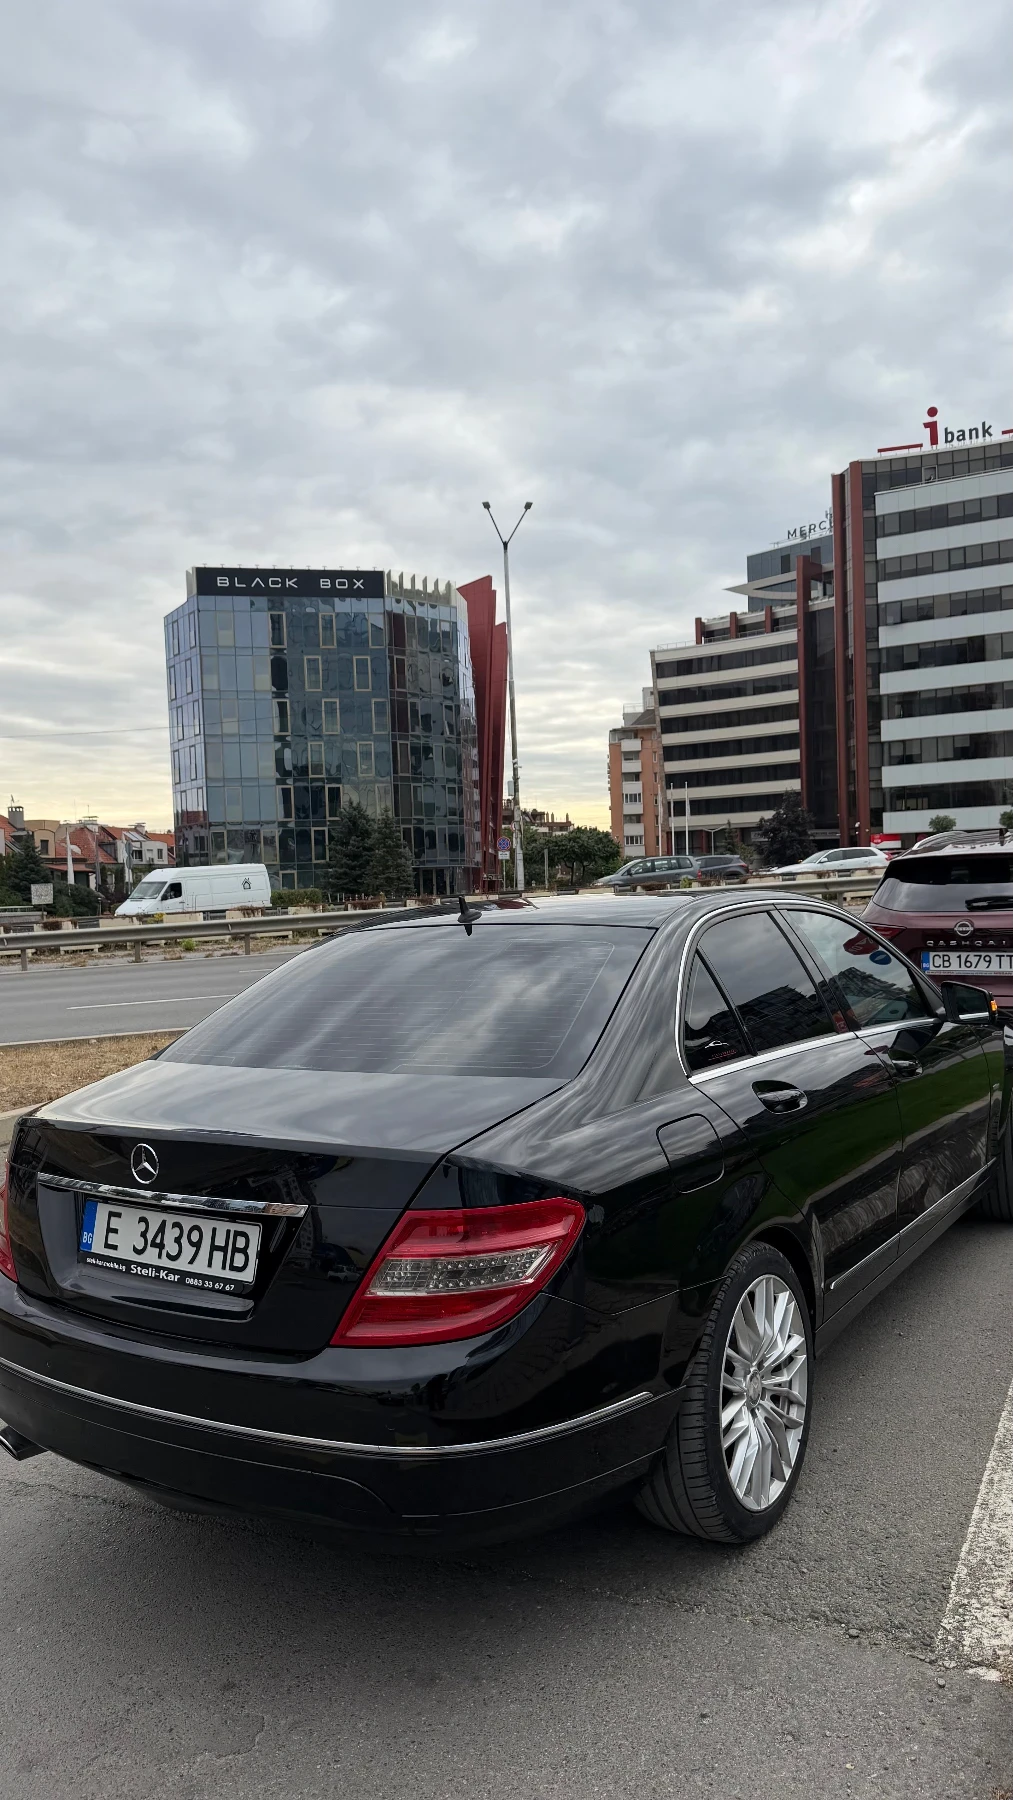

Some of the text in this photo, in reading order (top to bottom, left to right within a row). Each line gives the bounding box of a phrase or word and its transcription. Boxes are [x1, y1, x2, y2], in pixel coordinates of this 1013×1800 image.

[923, 406, 993, 446] i bank
[216, 576, 365, 590] BLACK BOX
[932, 954, 952, 968] CB
[956, 954, 992, 969] 1679
[995, 954, 1013, 969] TT
[82, 1210, 250, 1273] BG E 3439 HB
[130, 1263, 180, 1282] Steli-Kar
[185, 1277, 203, 1287] 0883
[204, 1279, 213, 1288] 33
[214, 1281, 224, 1290] 67
[225, 1283, 235, 1292] 67
